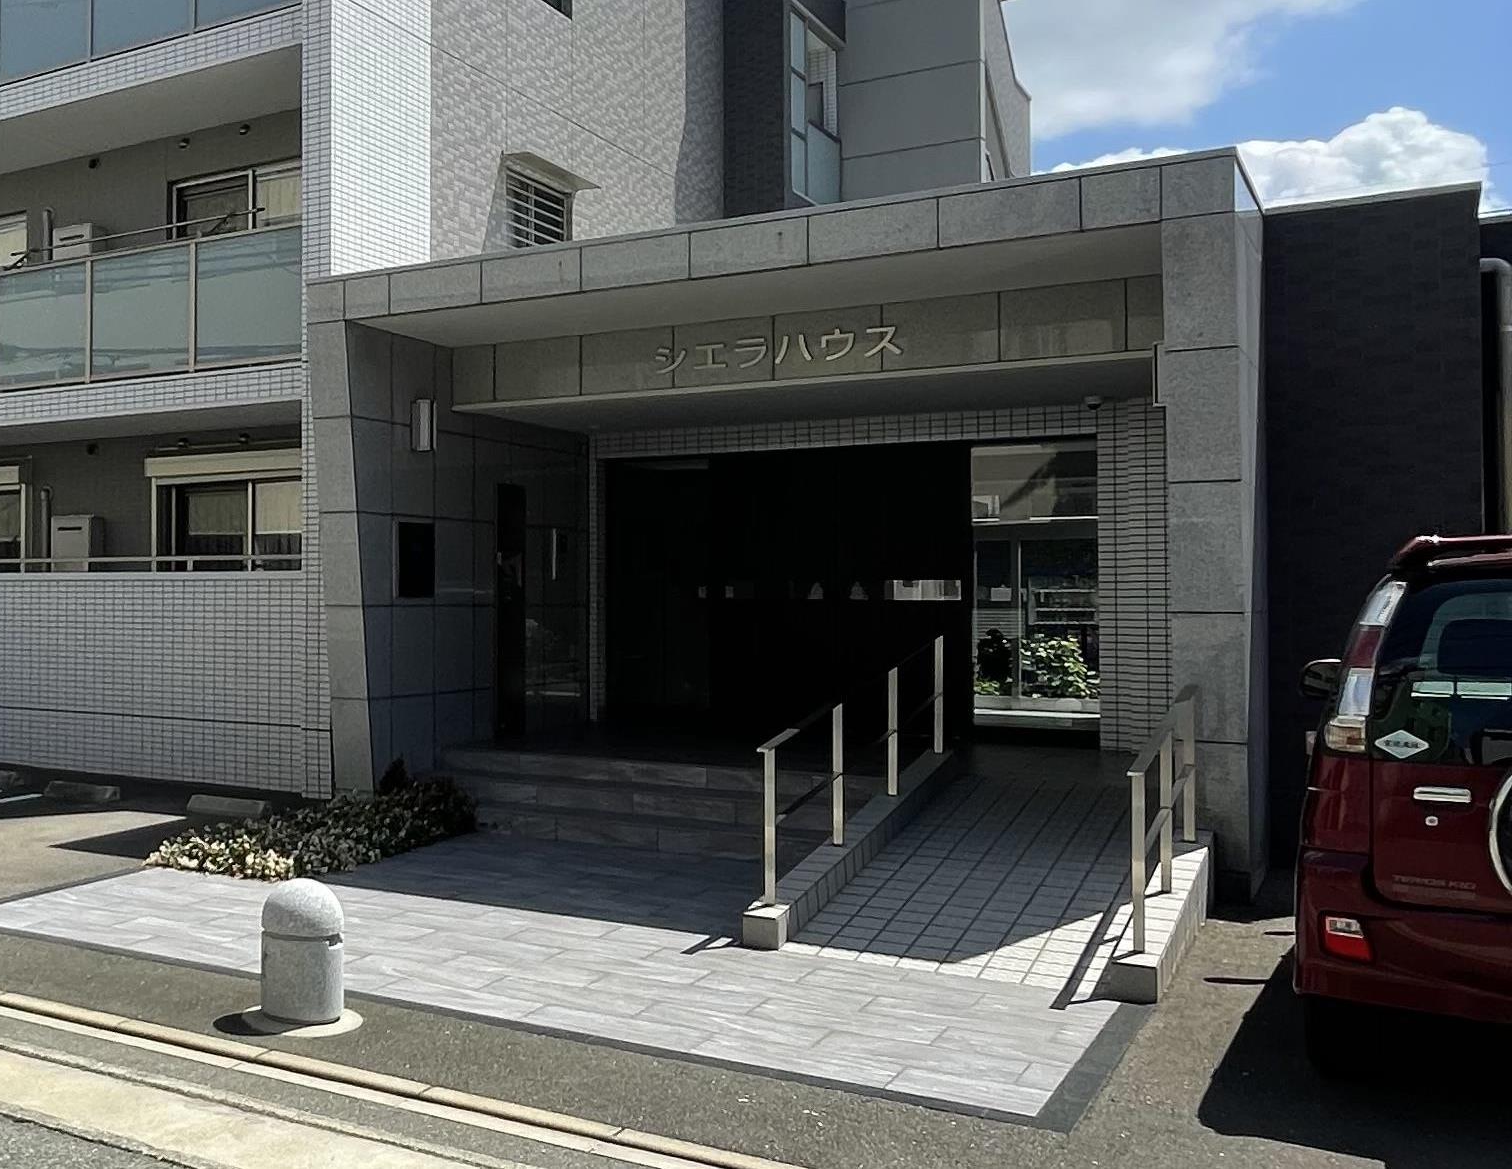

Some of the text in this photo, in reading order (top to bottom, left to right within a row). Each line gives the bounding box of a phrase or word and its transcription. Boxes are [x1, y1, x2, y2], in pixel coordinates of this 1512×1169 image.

[655, 326, 903, 374] シエラハウス
